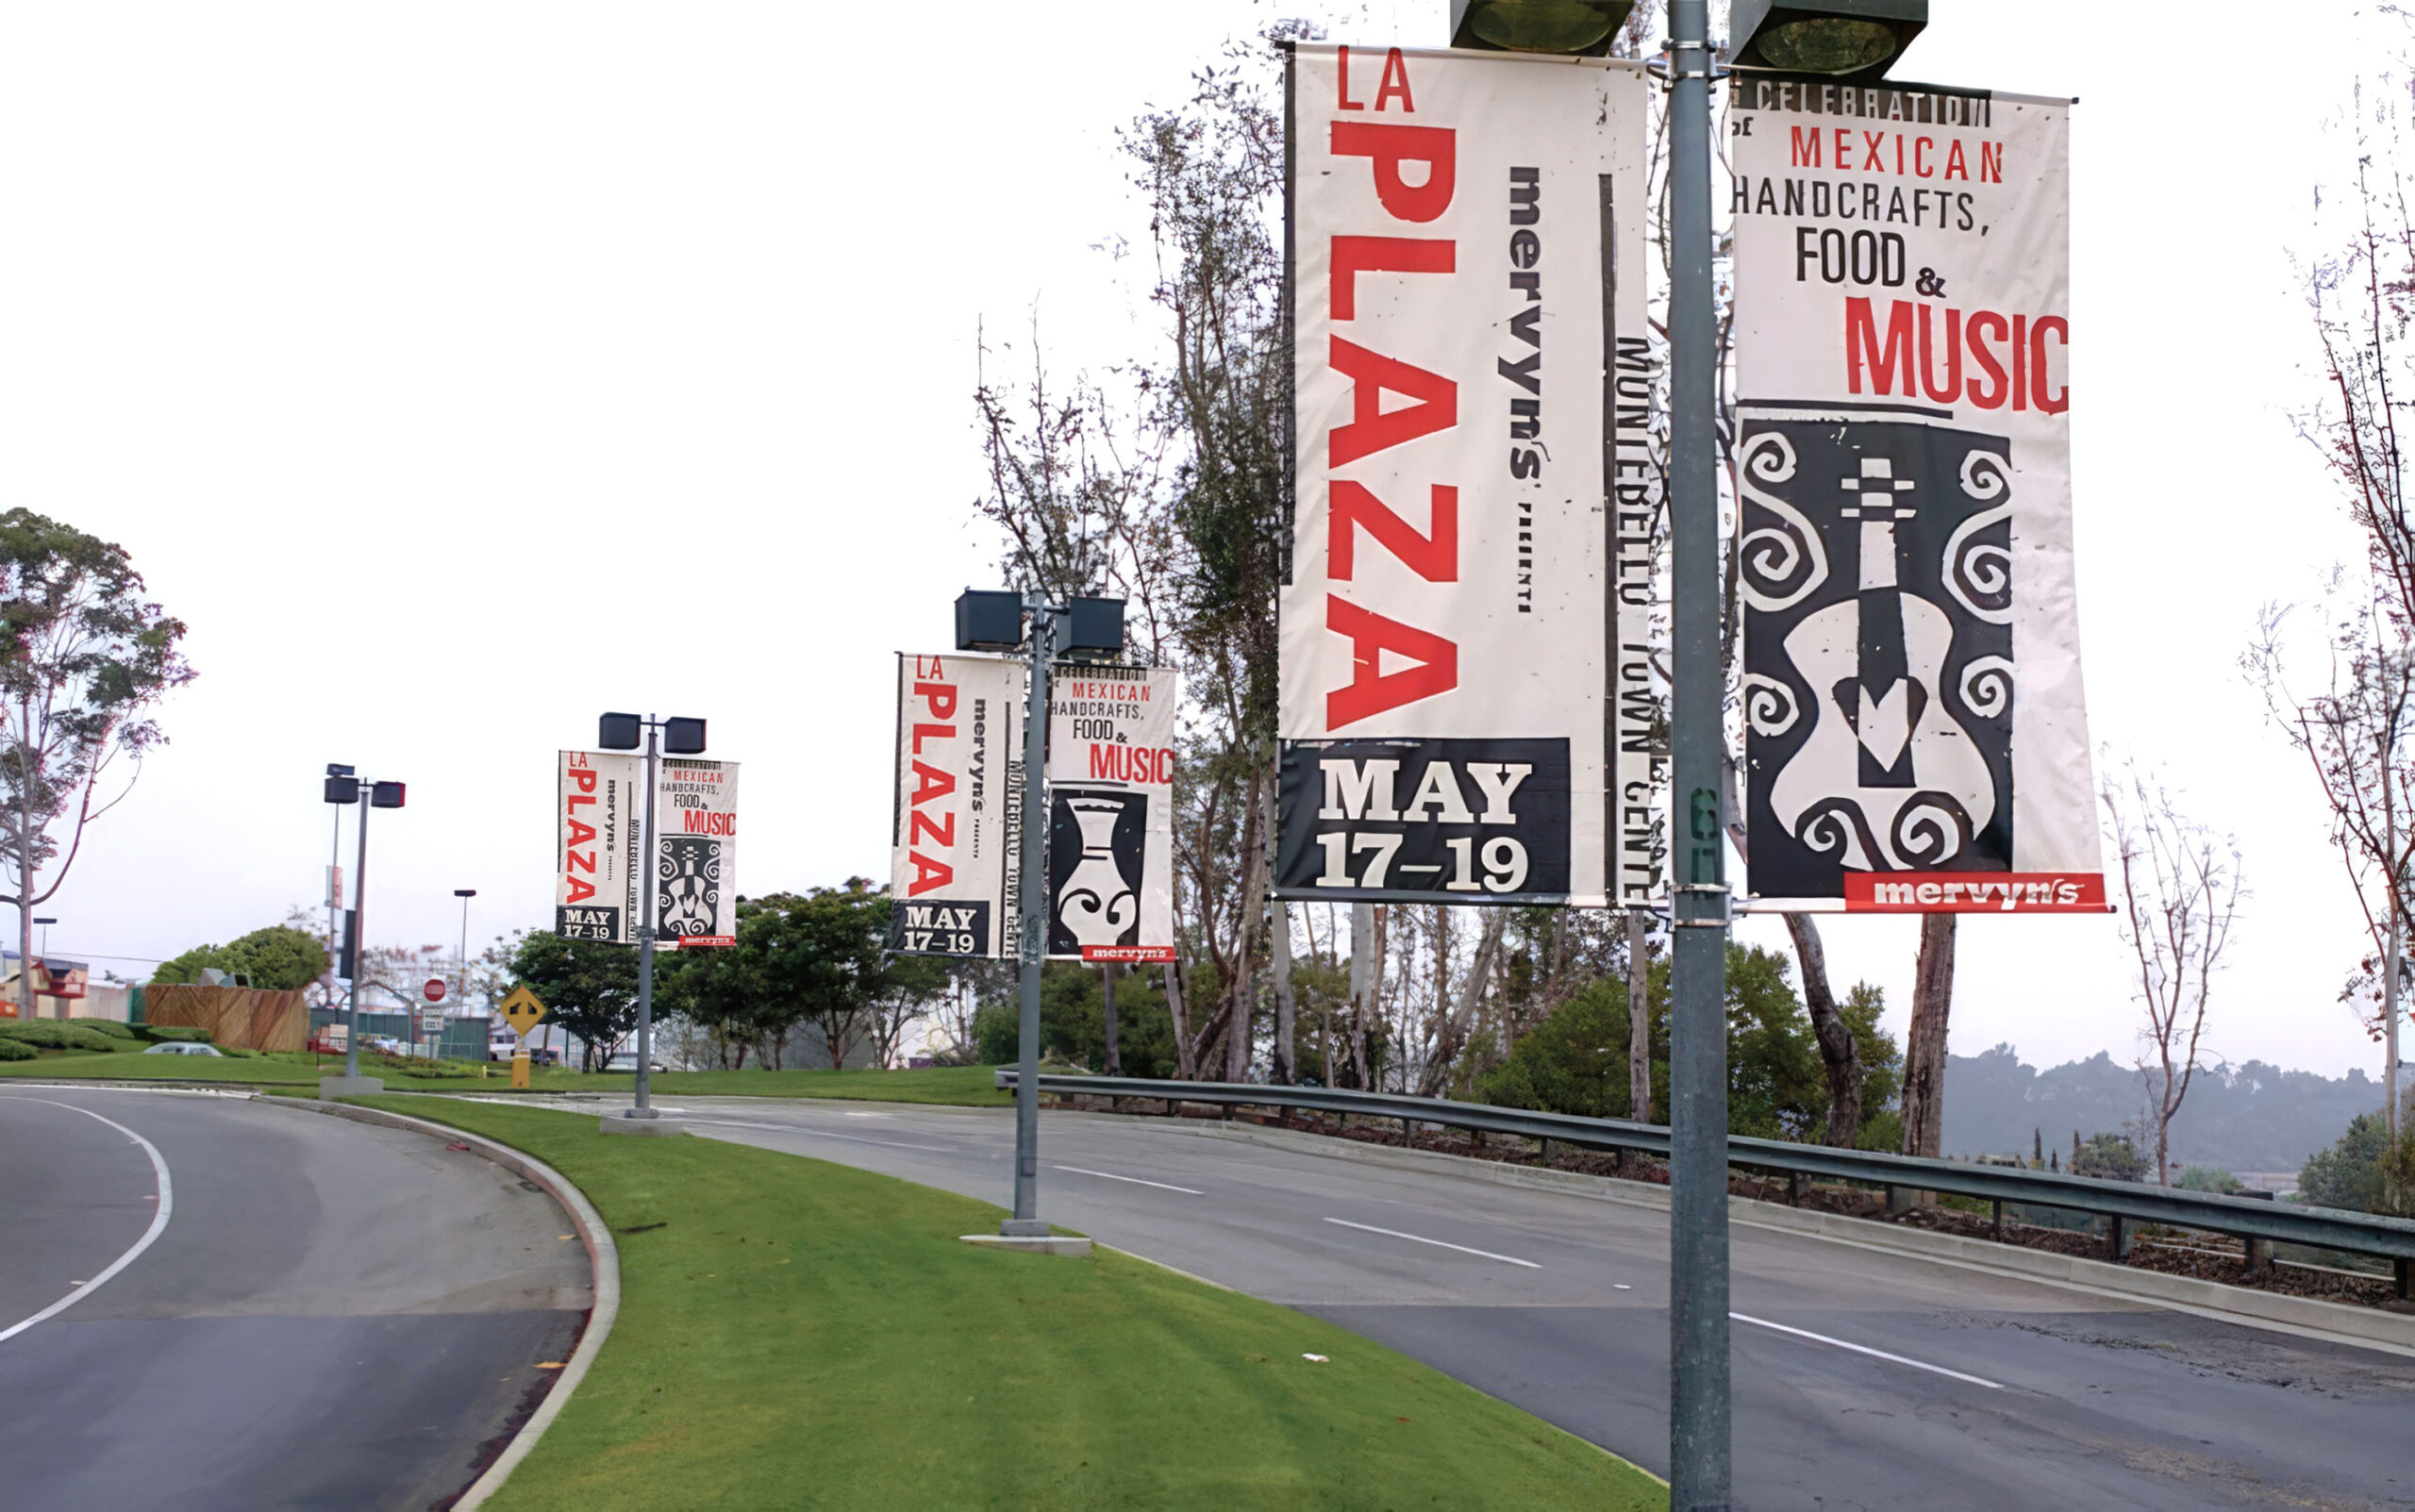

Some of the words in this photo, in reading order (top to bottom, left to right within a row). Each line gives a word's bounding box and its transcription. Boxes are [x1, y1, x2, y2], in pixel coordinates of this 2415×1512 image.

[1338, 46, 1415, 112] LA
[1790, 125, 2003, 184] MEXICAN
[1732, 175, 1990, 237] HANDCRAFTS,
[1796, 226, 1906, 288] FOOD
[1915, 267, 1947, 299] &
[1498, 166, 1551, 480] mervyn's
[1845, 296, 2069, 415] MUSIC
[1328, 120, 1458, 732] PLAZA
[916, 654, 944, 680] LA
[1050, 701, 1144, 721] HANDCRAFTS,
[1072, 682, 1151, 702] MEXICAN
[1073, 719, 1113, 740] FOOD
[1115, 732, 1128, 744] &
[569, 751, 588, 768] LA
[674, 770, 724, 784] MEXICAN
[1089, 743, 1175, 785] MUSIC
[674, 793, 700, 808] FOOD
[701, 802, 708, 810] &
[908, 682, 958, 898] PLAZA
[1318, 758, 1532, 824] MAY
[567, 769, 597, 905] PLAZA
[684, 809, 737, 837] MUSIC
[1624, 781, 1651, 908] CENTE
[1874, 878, 2086, 911] mervyn's
[565, 909, 611, 925] MAY
[905, 906, 977, 931] MAY
